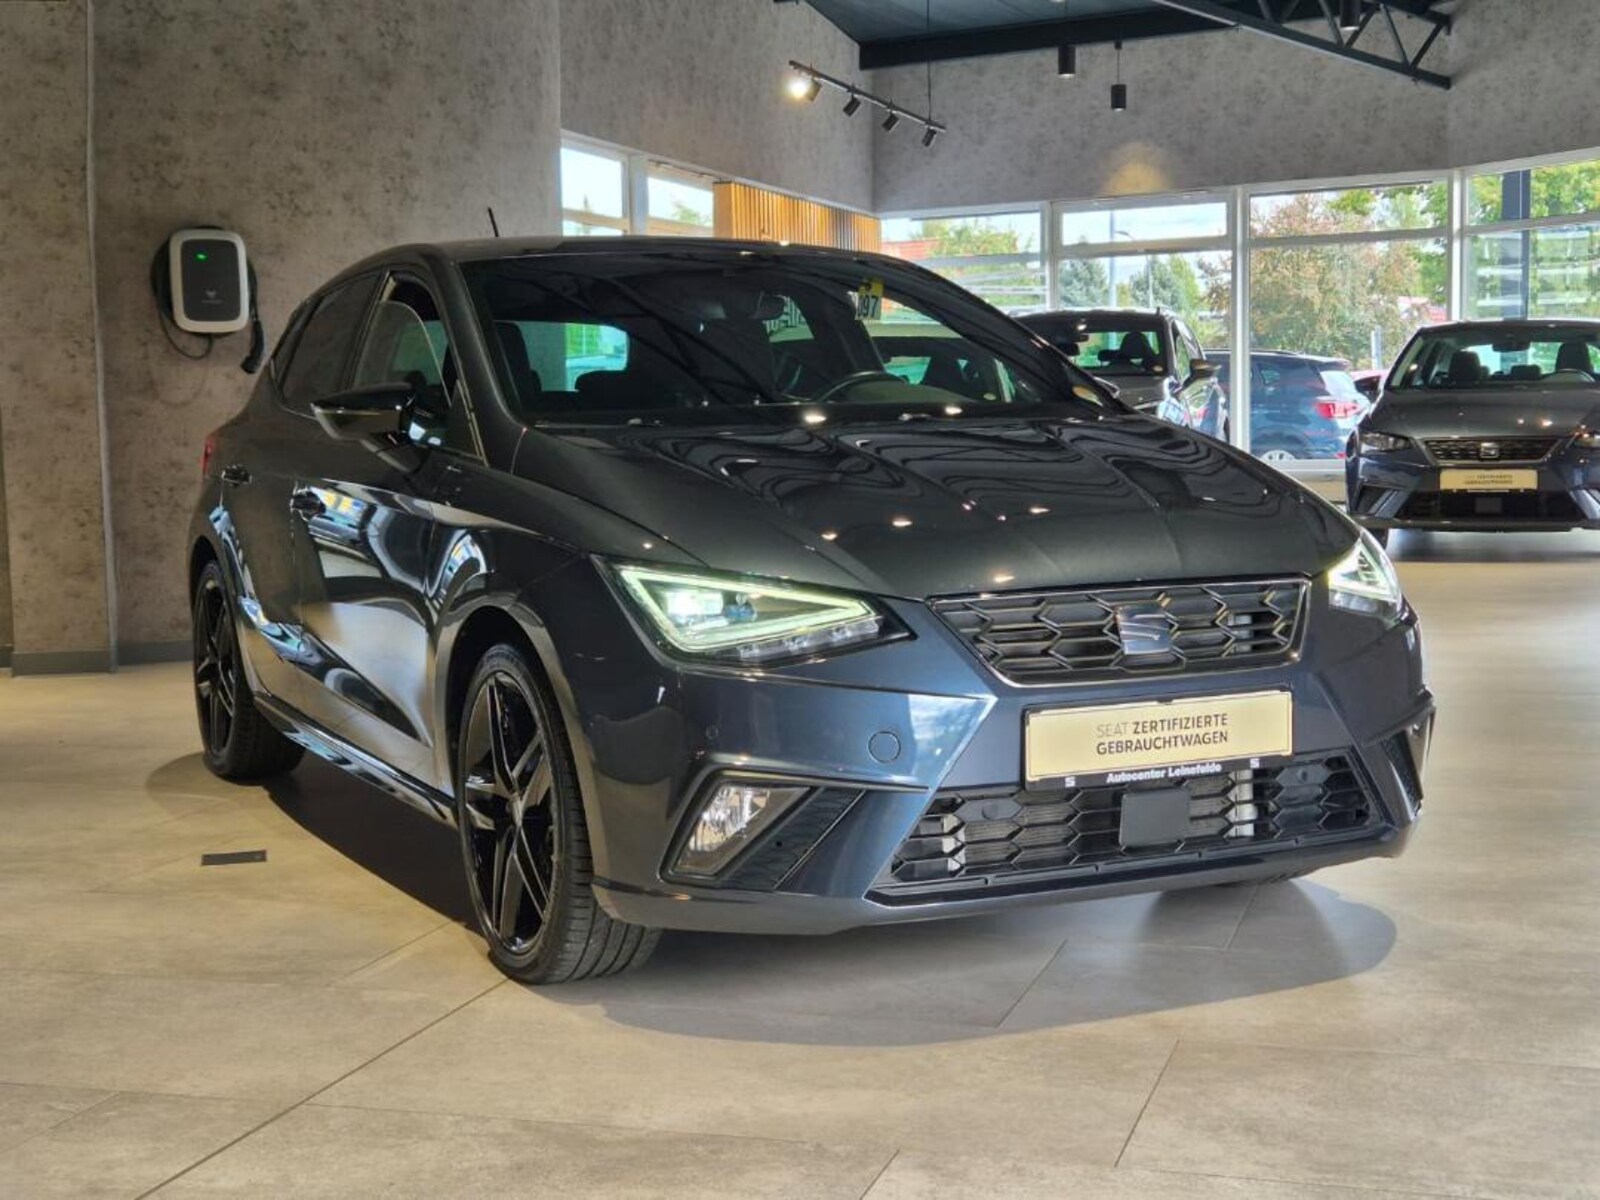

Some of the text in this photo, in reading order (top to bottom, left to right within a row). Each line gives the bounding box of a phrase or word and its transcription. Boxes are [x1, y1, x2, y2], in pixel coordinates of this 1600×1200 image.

[1096, 713, 1228, 738] SEAT ZERTIFIZIERTE
[1096, 731, 1229, 756] GEBRAUCHTWAGEN
[1106, 768, 1165, 784] Autocenter
